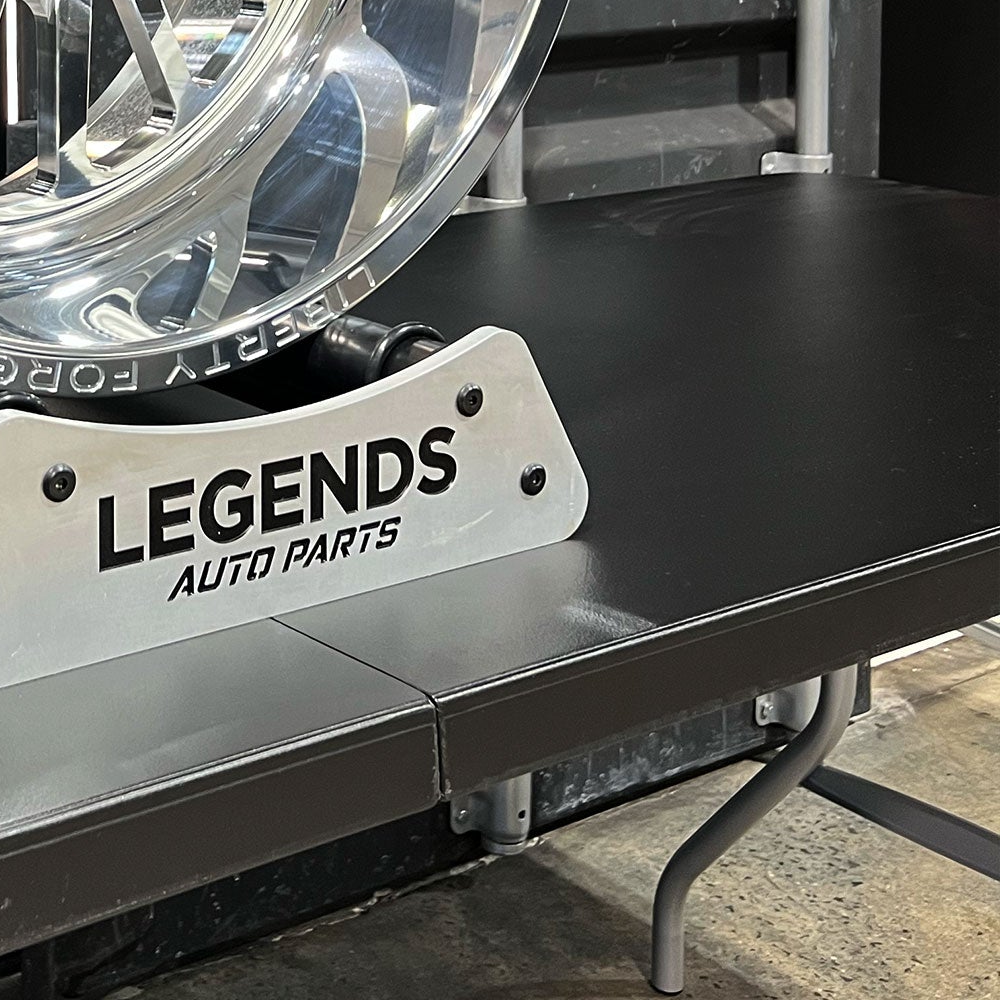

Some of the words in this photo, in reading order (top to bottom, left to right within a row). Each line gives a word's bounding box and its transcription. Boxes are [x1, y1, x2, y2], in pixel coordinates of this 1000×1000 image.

[165, 261, 377, 387] LIBERTY
[99, 426, 458, 572] LEGENDS
[166, 546, 276, 602] AUTO
[282, 515, 402, 573] PARTS
